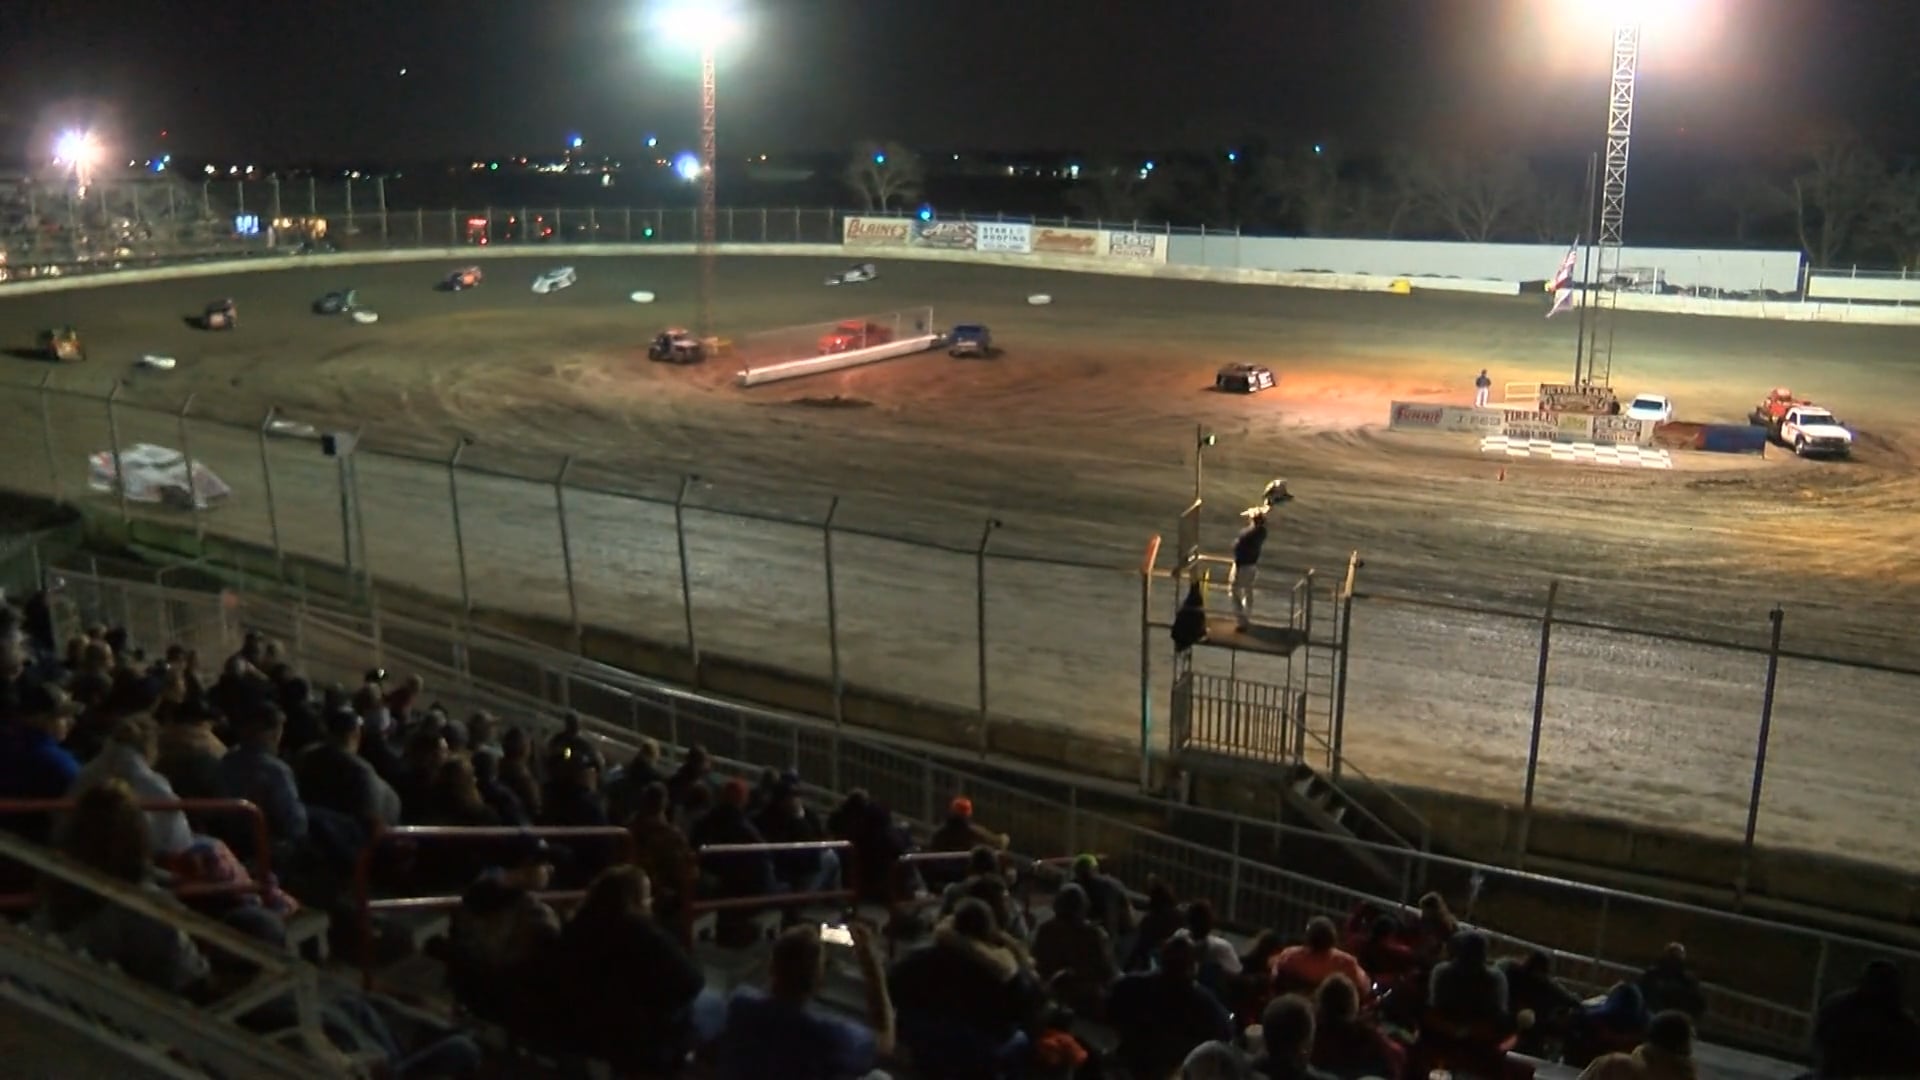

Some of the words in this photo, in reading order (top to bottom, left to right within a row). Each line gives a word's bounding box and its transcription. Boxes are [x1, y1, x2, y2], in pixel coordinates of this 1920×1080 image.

[983, 234, 1026, 243] ROOFING
[1503, 409, 1530, 423] TIRE
[1531, 410, 1559, 427] PLUS
